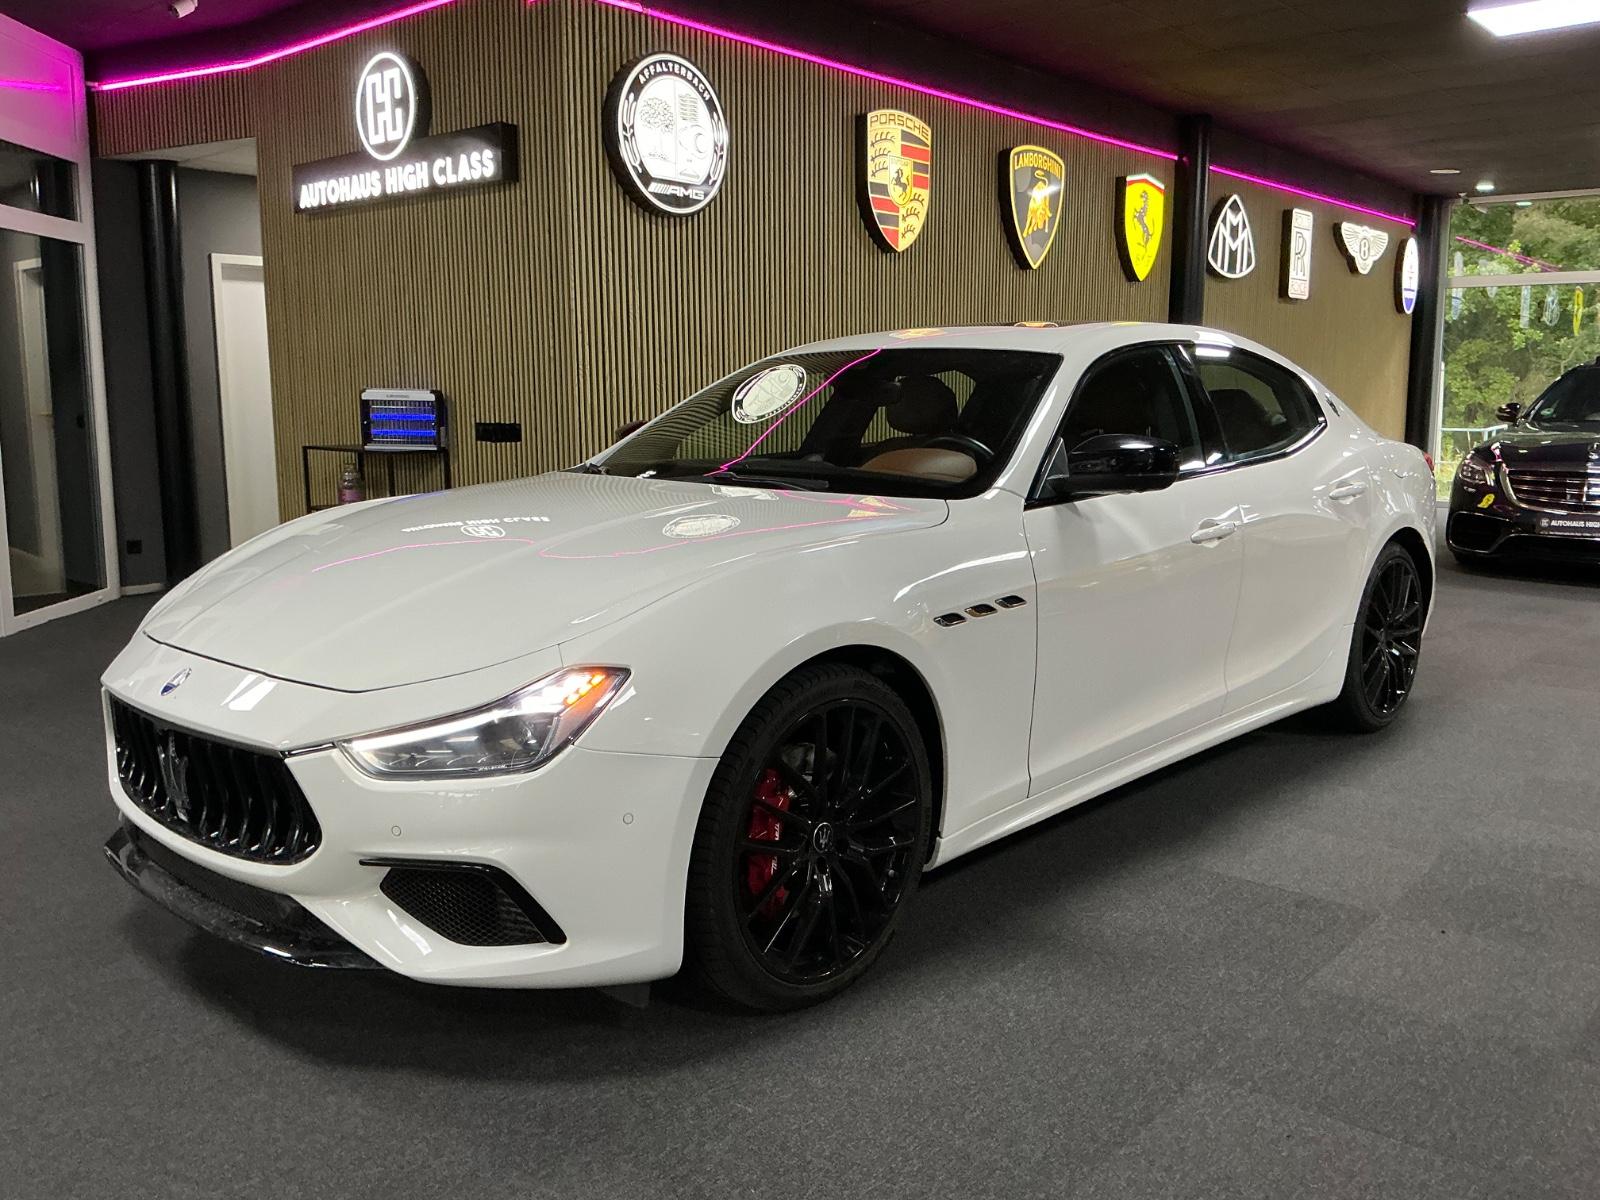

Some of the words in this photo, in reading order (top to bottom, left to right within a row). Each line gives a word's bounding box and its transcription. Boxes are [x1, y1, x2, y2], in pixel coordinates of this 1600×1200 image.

[638, 61, 711, 101] AFFALTERBACH
[870, 113, 930, 141] PORSCHE
[299, 171, 381, 209] AUTOHAUS
[385, 161, 429, 194] HIGH
[432, 149, 495, 186] CLASS
[1014, 151, 1061, 180] LAMBORGHINI
[1550, 519, 1584, 528] AUTOHAUS
